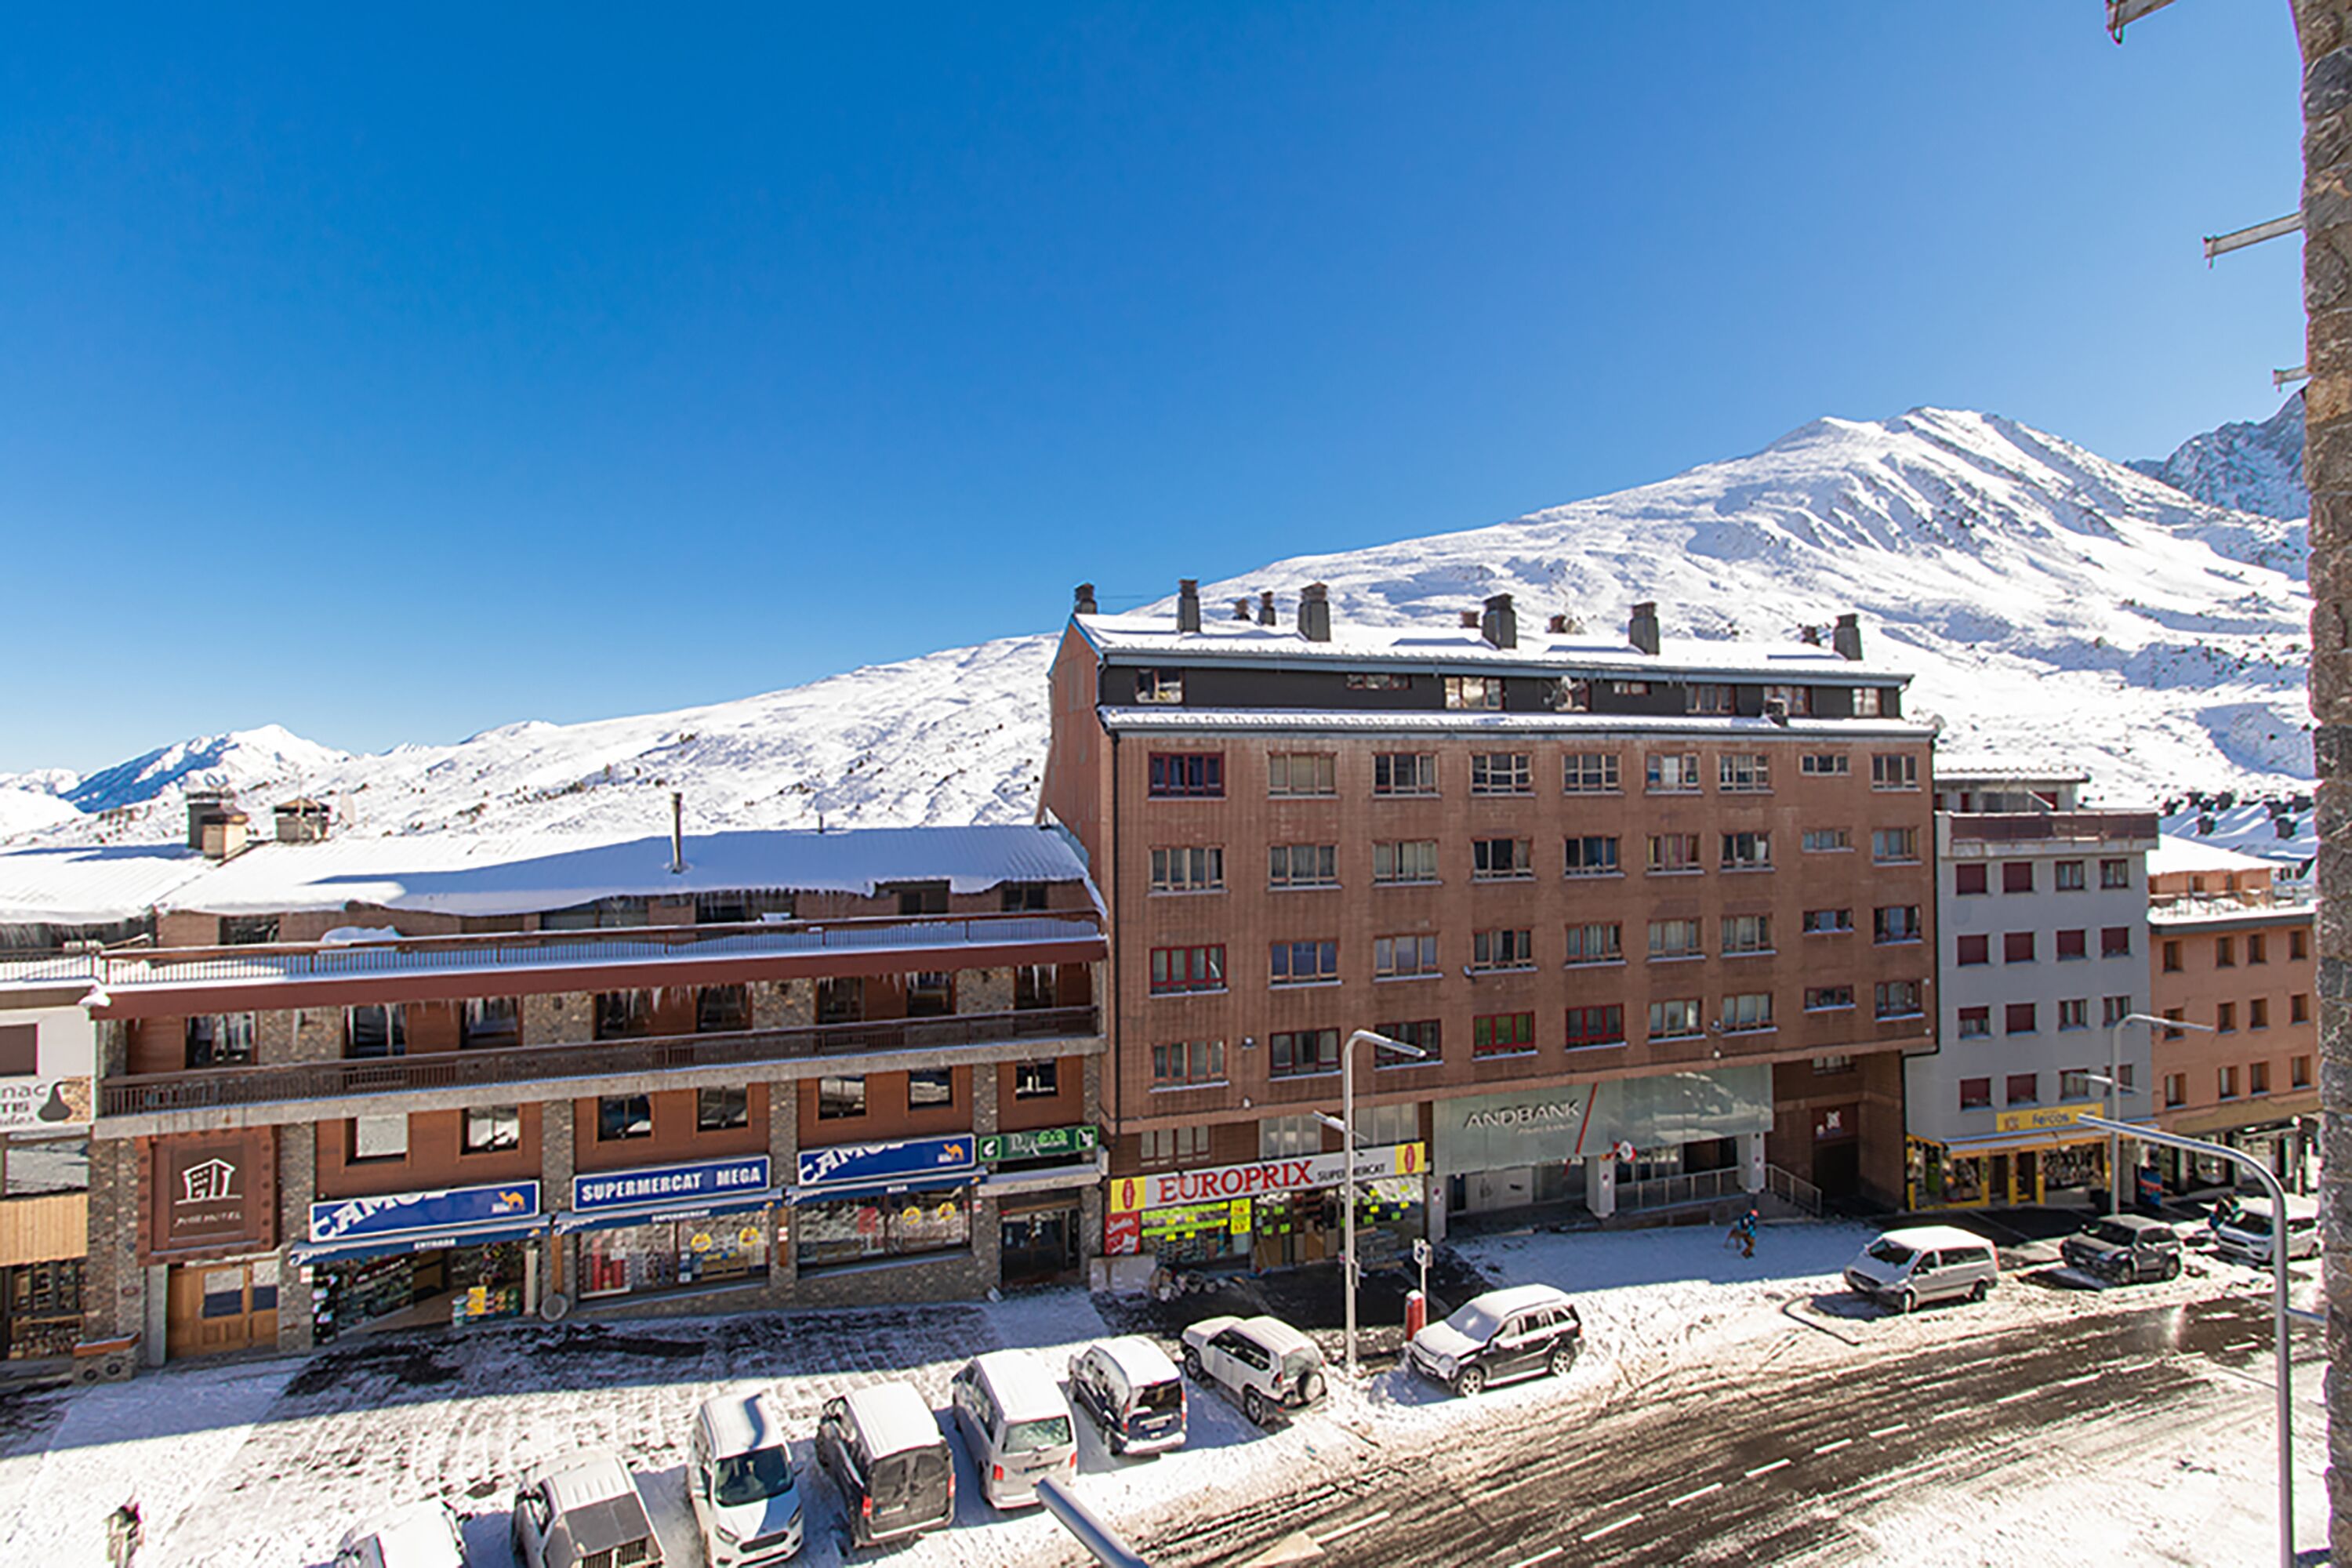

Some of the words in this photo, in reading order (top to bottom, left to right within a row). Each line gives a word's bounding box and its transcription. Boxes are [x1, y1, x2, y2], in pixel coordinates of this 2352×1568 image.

[1465, 1099, 1581, 1130] ANDBANK
[582, 1172, 703, 1202] SUPERMERCAT
[716, 1167, 761, 1186] MEGA
[1157, 1160, 1314, 1203] EUROPRIX
[1317, 1163, 1385, 1182] SUPEMERCAT
